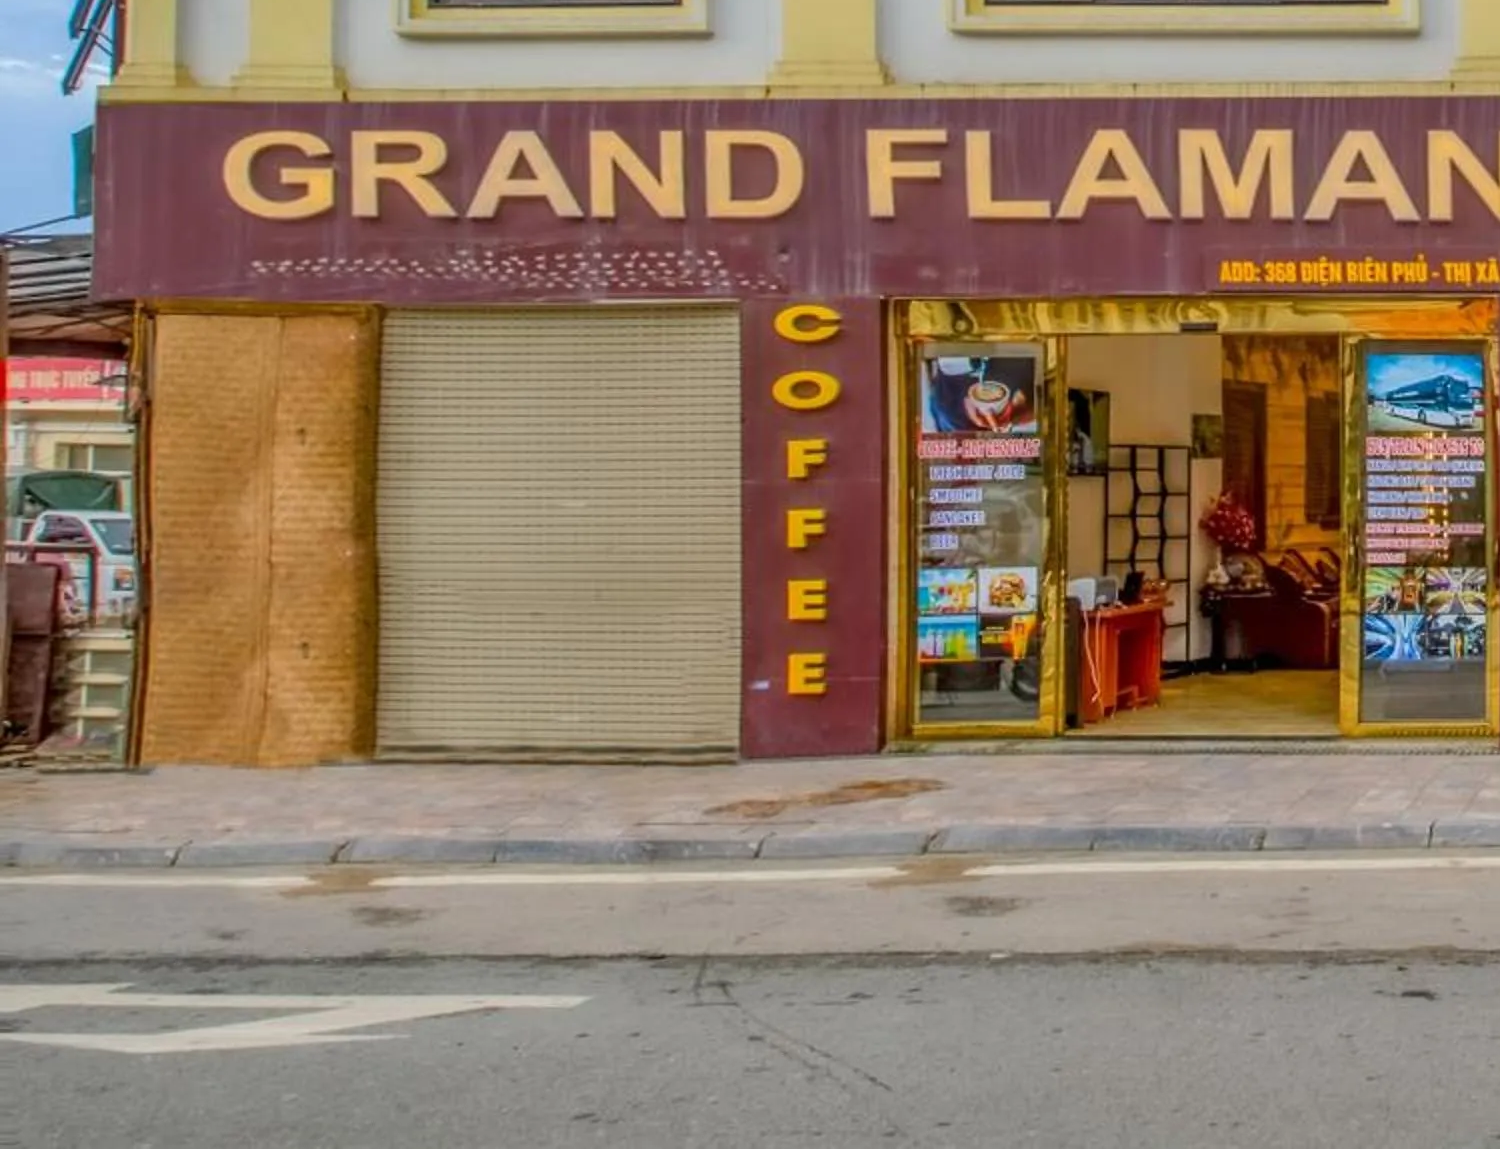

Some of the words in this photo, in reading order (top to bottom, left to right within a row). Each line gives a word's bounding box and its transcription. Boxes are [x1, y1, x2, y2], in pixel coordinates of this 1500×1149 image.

[222, 129, 805, 219] GRAND
[1220, 260, 1261, 284] ADD:
[773, 304, 841, 695] COFFEE
